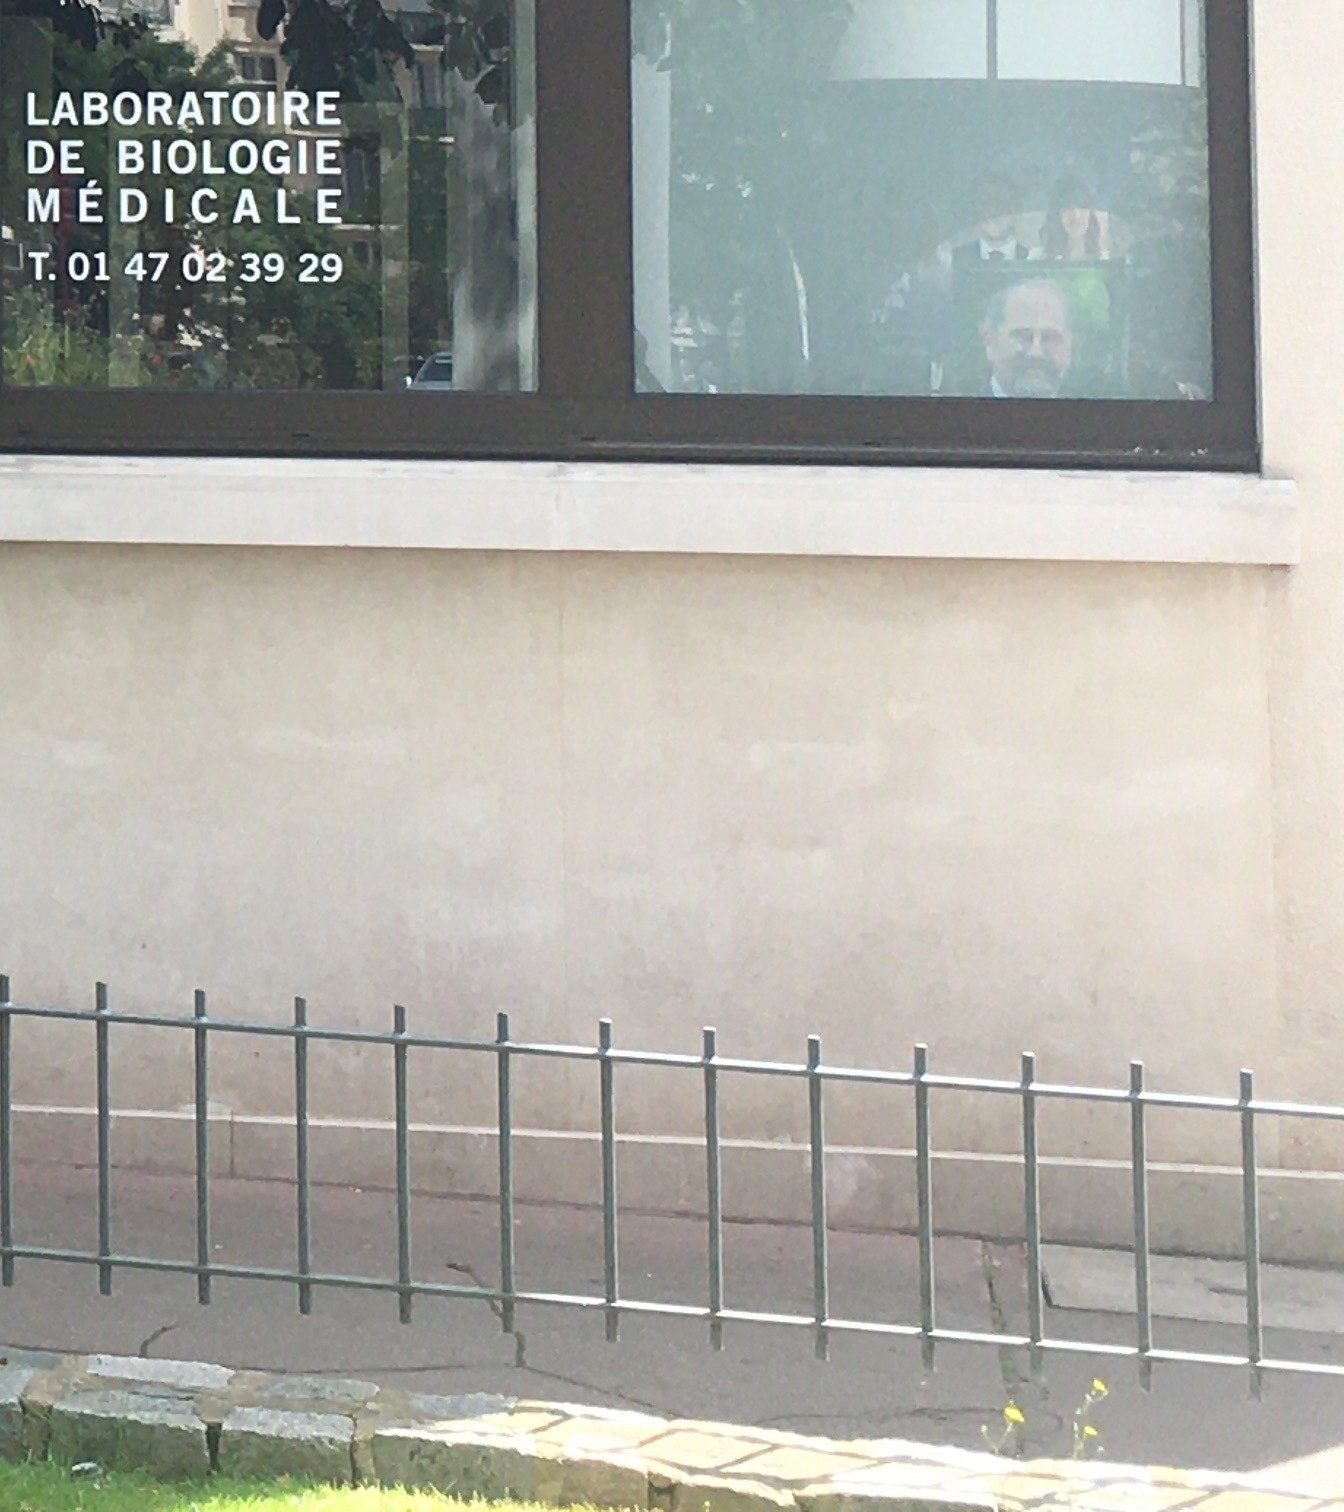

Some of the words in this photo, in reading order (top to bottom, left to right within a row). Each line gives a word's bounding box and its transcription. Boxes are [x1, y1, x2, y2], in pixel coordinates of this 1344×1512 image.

[25, 90, 342, 127] LABORATOIRE
[26, 139, 86, 175] DE
[117, 139, 342, 175] BIOLOGIE
[26, 179, 343, 224] MÉDICALE
[28, 251, 57, 281] T.
[67, 251, 110, 282] 01
[124, 252, 170, 282] 47
[182, 252, 226, 282] 02
[239, 252, 284, 283] 39
[297, 252, 343, 283] 29
